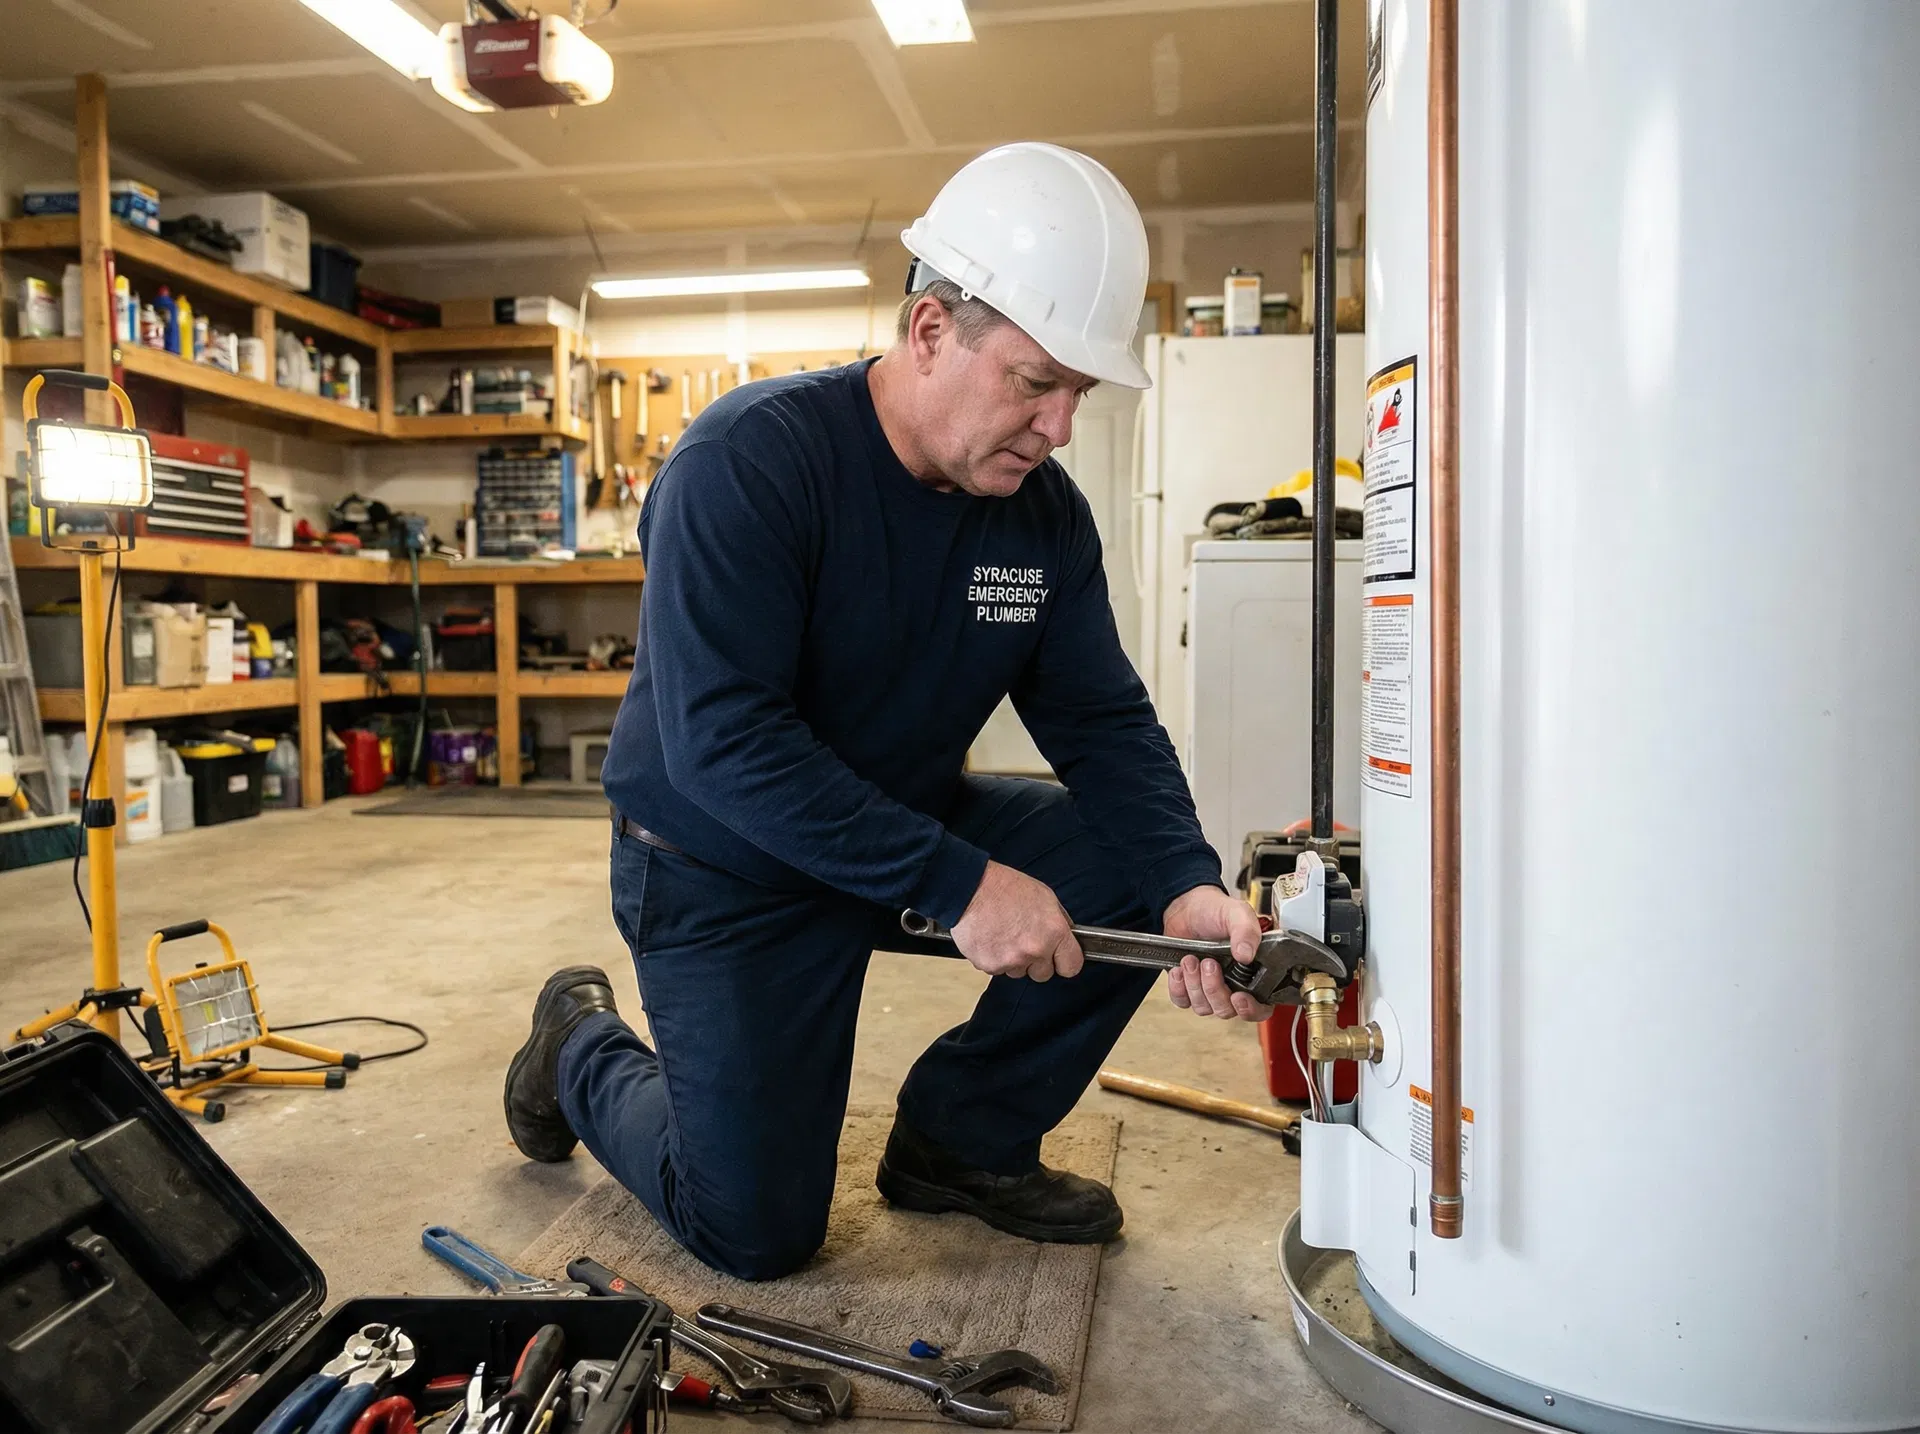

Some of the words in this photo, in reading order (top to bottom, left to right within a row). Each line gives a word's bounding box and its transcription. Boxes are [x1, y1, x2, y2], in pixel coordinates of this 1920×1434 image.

[973, 566, 1043, 584] SYRACUSE
[968, 586, 1049, 603] EMERGENCY
[977, 606, 1037, 622] PLUMBER
